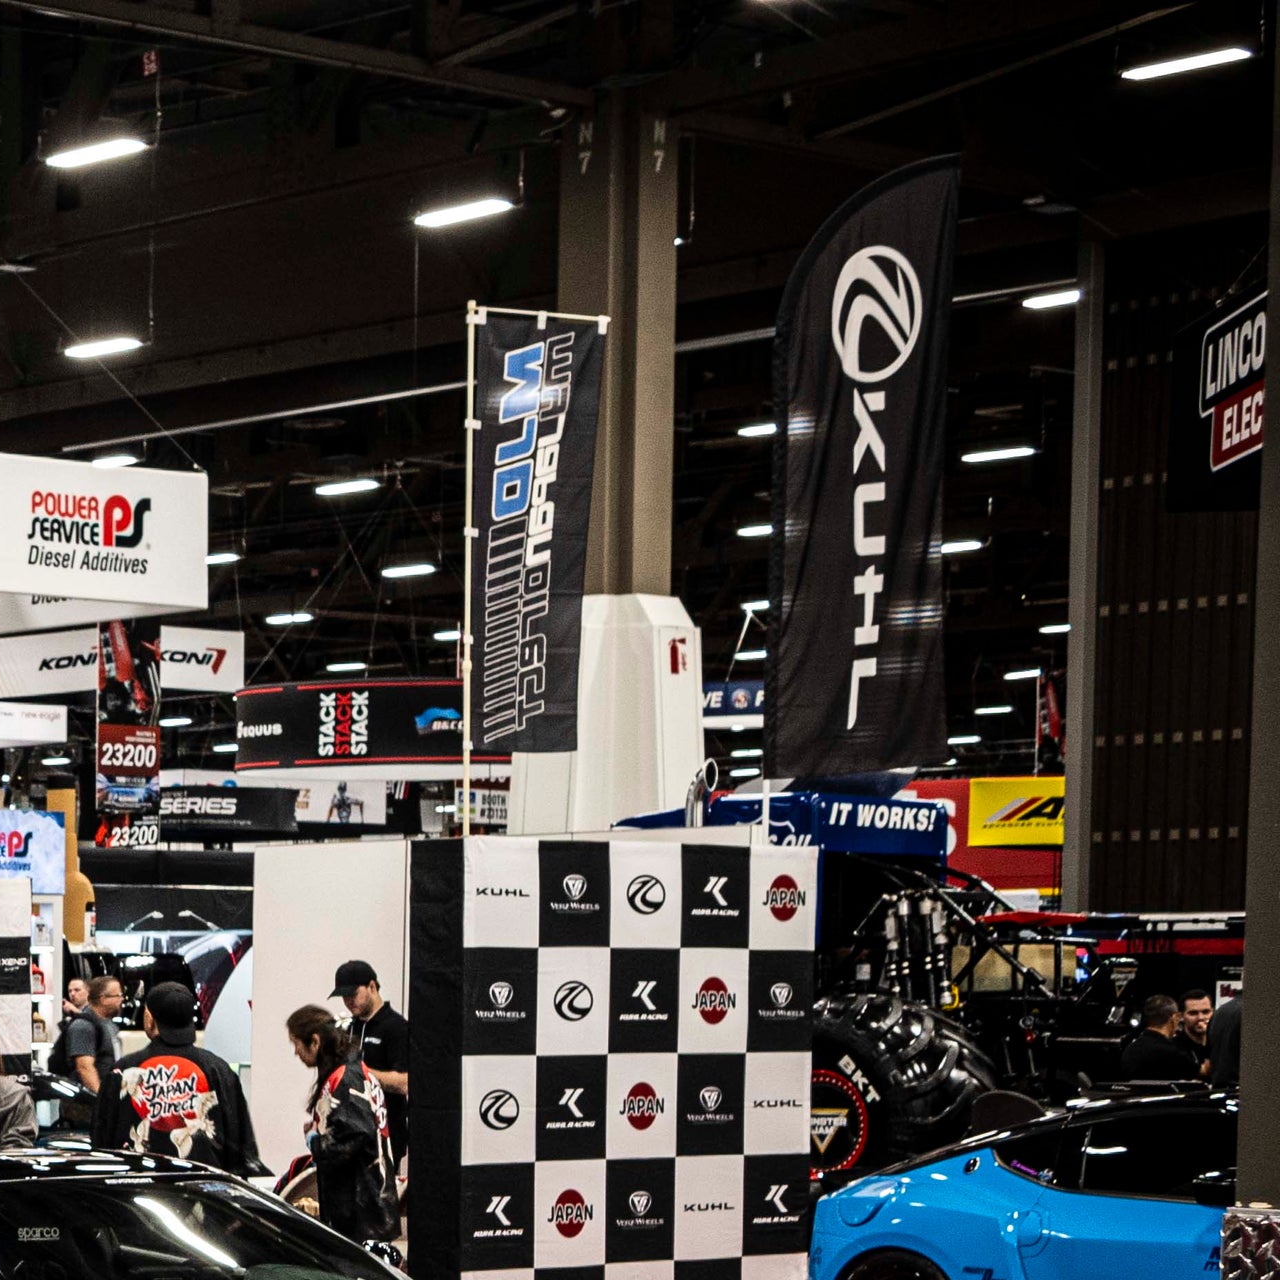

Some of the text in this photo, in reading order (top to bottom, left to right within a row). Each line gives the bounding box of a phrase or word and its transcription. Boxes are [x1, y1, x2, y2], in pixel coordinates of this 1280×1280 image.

[1206, 312, 1266, 399] LINCO
[1222, 390, 1265, 451] ELEC
[31, 491, 99, 520] POWER
[28, 517, 99, 546] SERVICE
[103, 495, 151, 548] PS
[28, 545, 148, 574] Diesel Additives
[850, 388, 886, 730] KUHL
[318, 692, 337, 756] STACK
[335, 692, 352, 755] STACK
[350, 690, 369, 755] STACK
[100, 743, 156, 767] 23200
[159, 797, 237, 815] SERIES
[829, 802, 852, 825] IT
[857, 805, 937, 831] WORKS!
[110, 825, 158, 847] 23200
[476, 888, 530, 897] KUHL
[763, 890, 806, 907] JAPAN
[692, 992, 736, 1010] JAPAN
[838, 1054, 880, 1103] BKT
[620, 1097, 664, 1116] JAPAN
[753, 1099, 802, 1108] KUHL
[548, 1204, 593, 1222] JAPAN
[684, 1202, 734, 1211] KUHL
[18, 1227, 59, 1239] sparco
